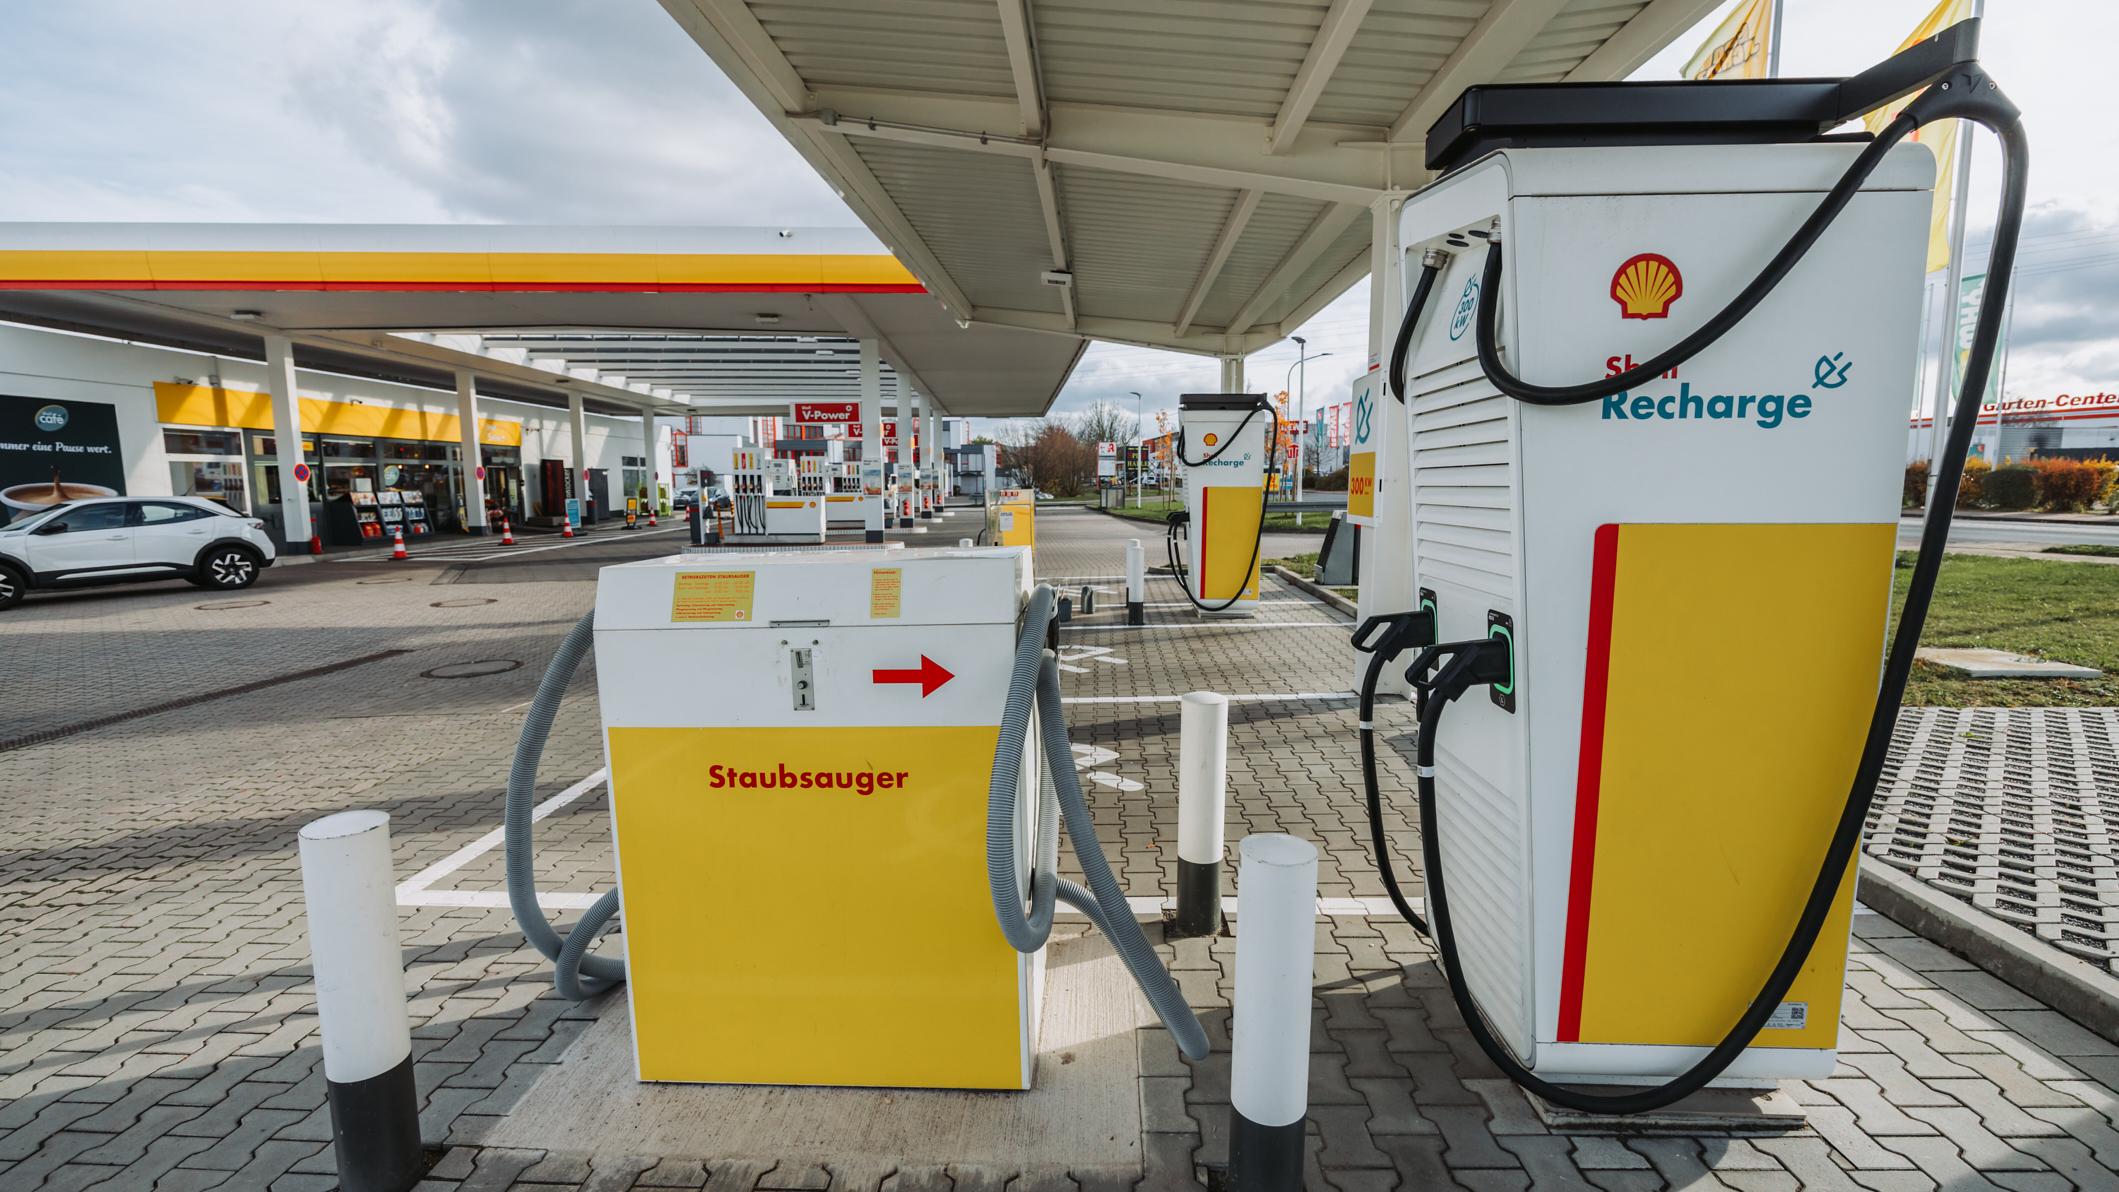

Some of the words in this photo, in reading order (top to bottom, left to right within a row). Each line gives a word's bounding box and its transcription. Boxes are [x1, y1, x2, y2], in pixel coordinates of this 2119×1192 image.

[1601, 382, 1813, 429] Recharge
[1983, 392, 2119, 411] Garten-Cente
[802, 411, 850, 420] V-Power
[32, 441, 53, 452] eine
[55, 442, 84, 453] Pause
[86, 446, 112, 454] wert.
[1351, 477, 1364, 495] 300
[709, 763, 909, 796] Staubsauger
